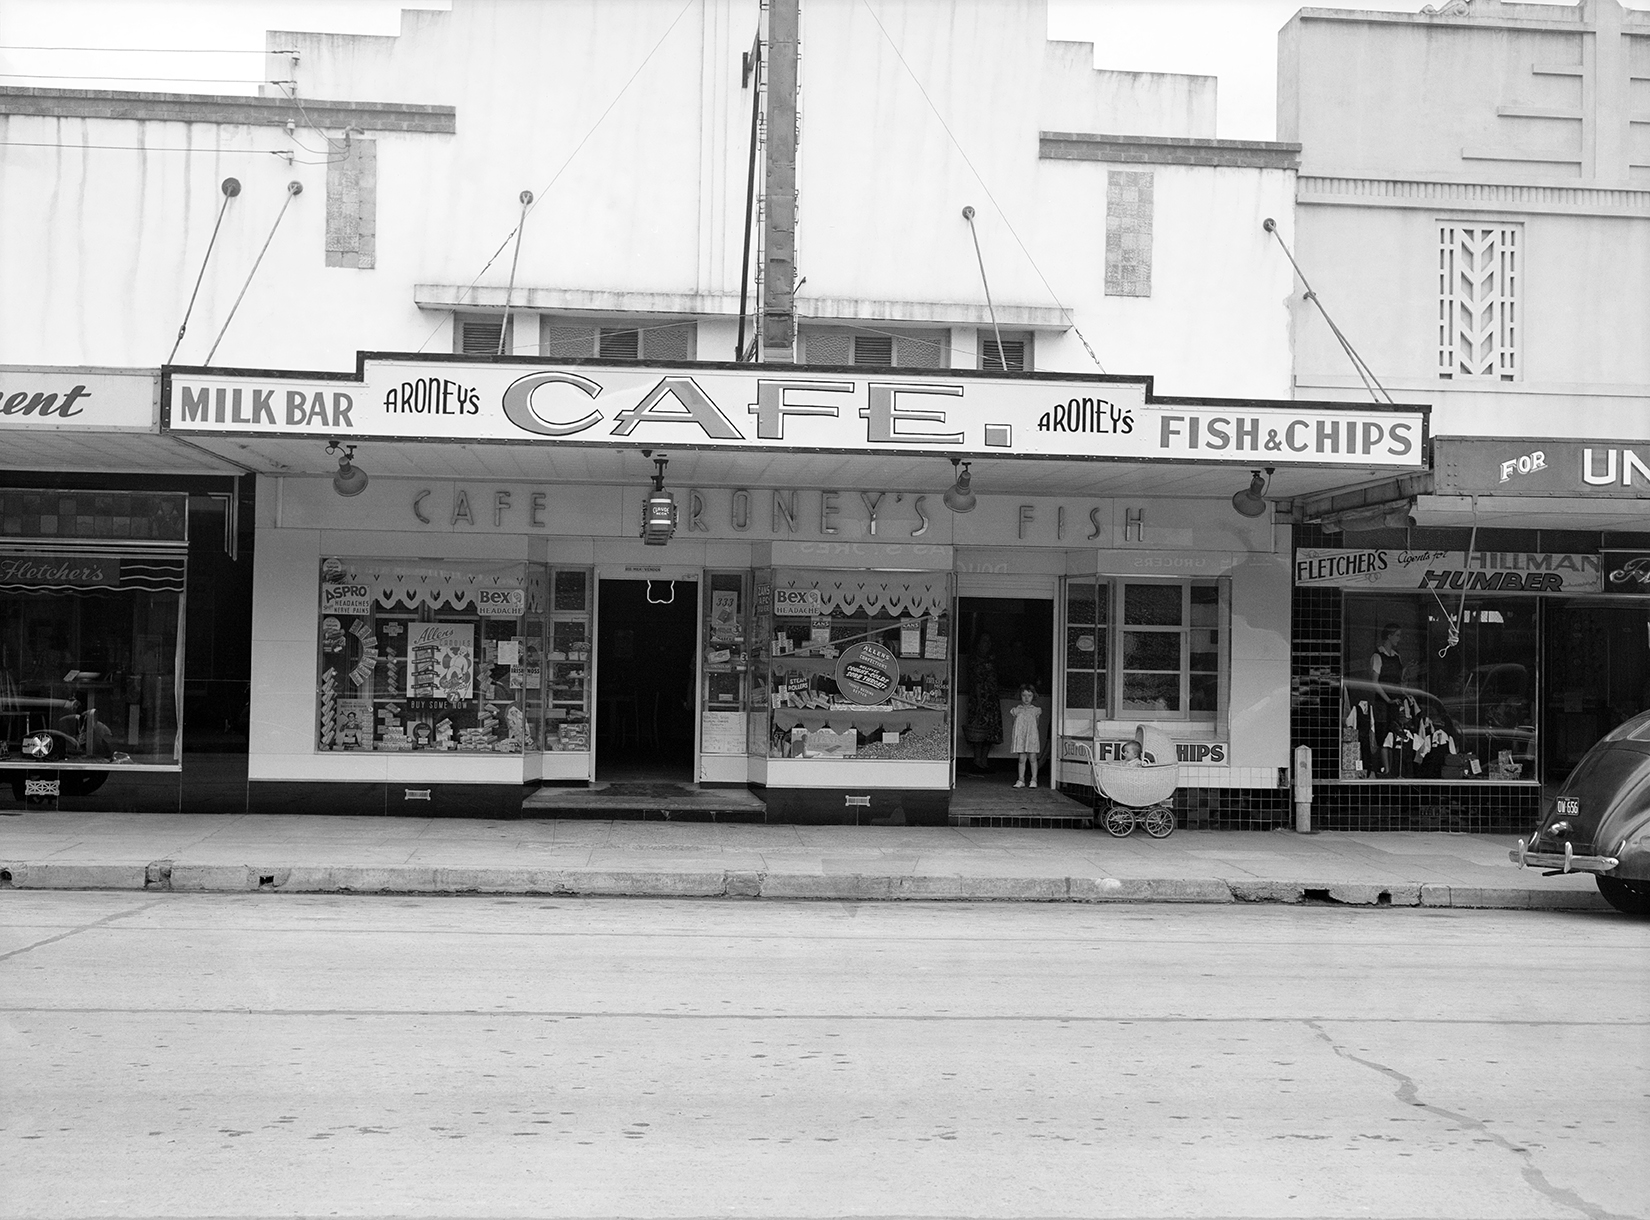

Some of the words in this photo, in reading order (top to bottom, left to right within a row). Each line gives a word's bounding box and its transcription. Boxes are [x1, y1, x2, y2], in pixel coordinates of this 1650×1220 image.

[0, 385, 92, 418] ent
[180, 385, 277, 425] MILK
[285, 391, 354, 428] BAR
[1498, 450, 1549, 484] FOR
[412, 488, 547, 528] CAFE
[688, 489, 929, 537] RONEY'S
[1018, 504, 1147, 542] FISH
[1, 559, 105, 582] Fletcher's
[1297, 549, 1389, 581] FLETCHER'S
[1397, 550, 1431, 569] Agents
[1464, 551, 1600, 573] HILLMAN
[1419, 569, 1564, 592] HUMBER
[325, 586, 367, 604] ASPRO
[480, 591, 511, 604] Bex
[716, 597, 734, 607] 333
[777, 591, 808, 604] Bex
[414, 626, 454, 645] Allen's
[410, 700, 426, 709] BUY
[428, 701, 448, 710] SOME
[452, 701, 468, 710] NOW
[1176, 744, 1226, 763] HIPS
